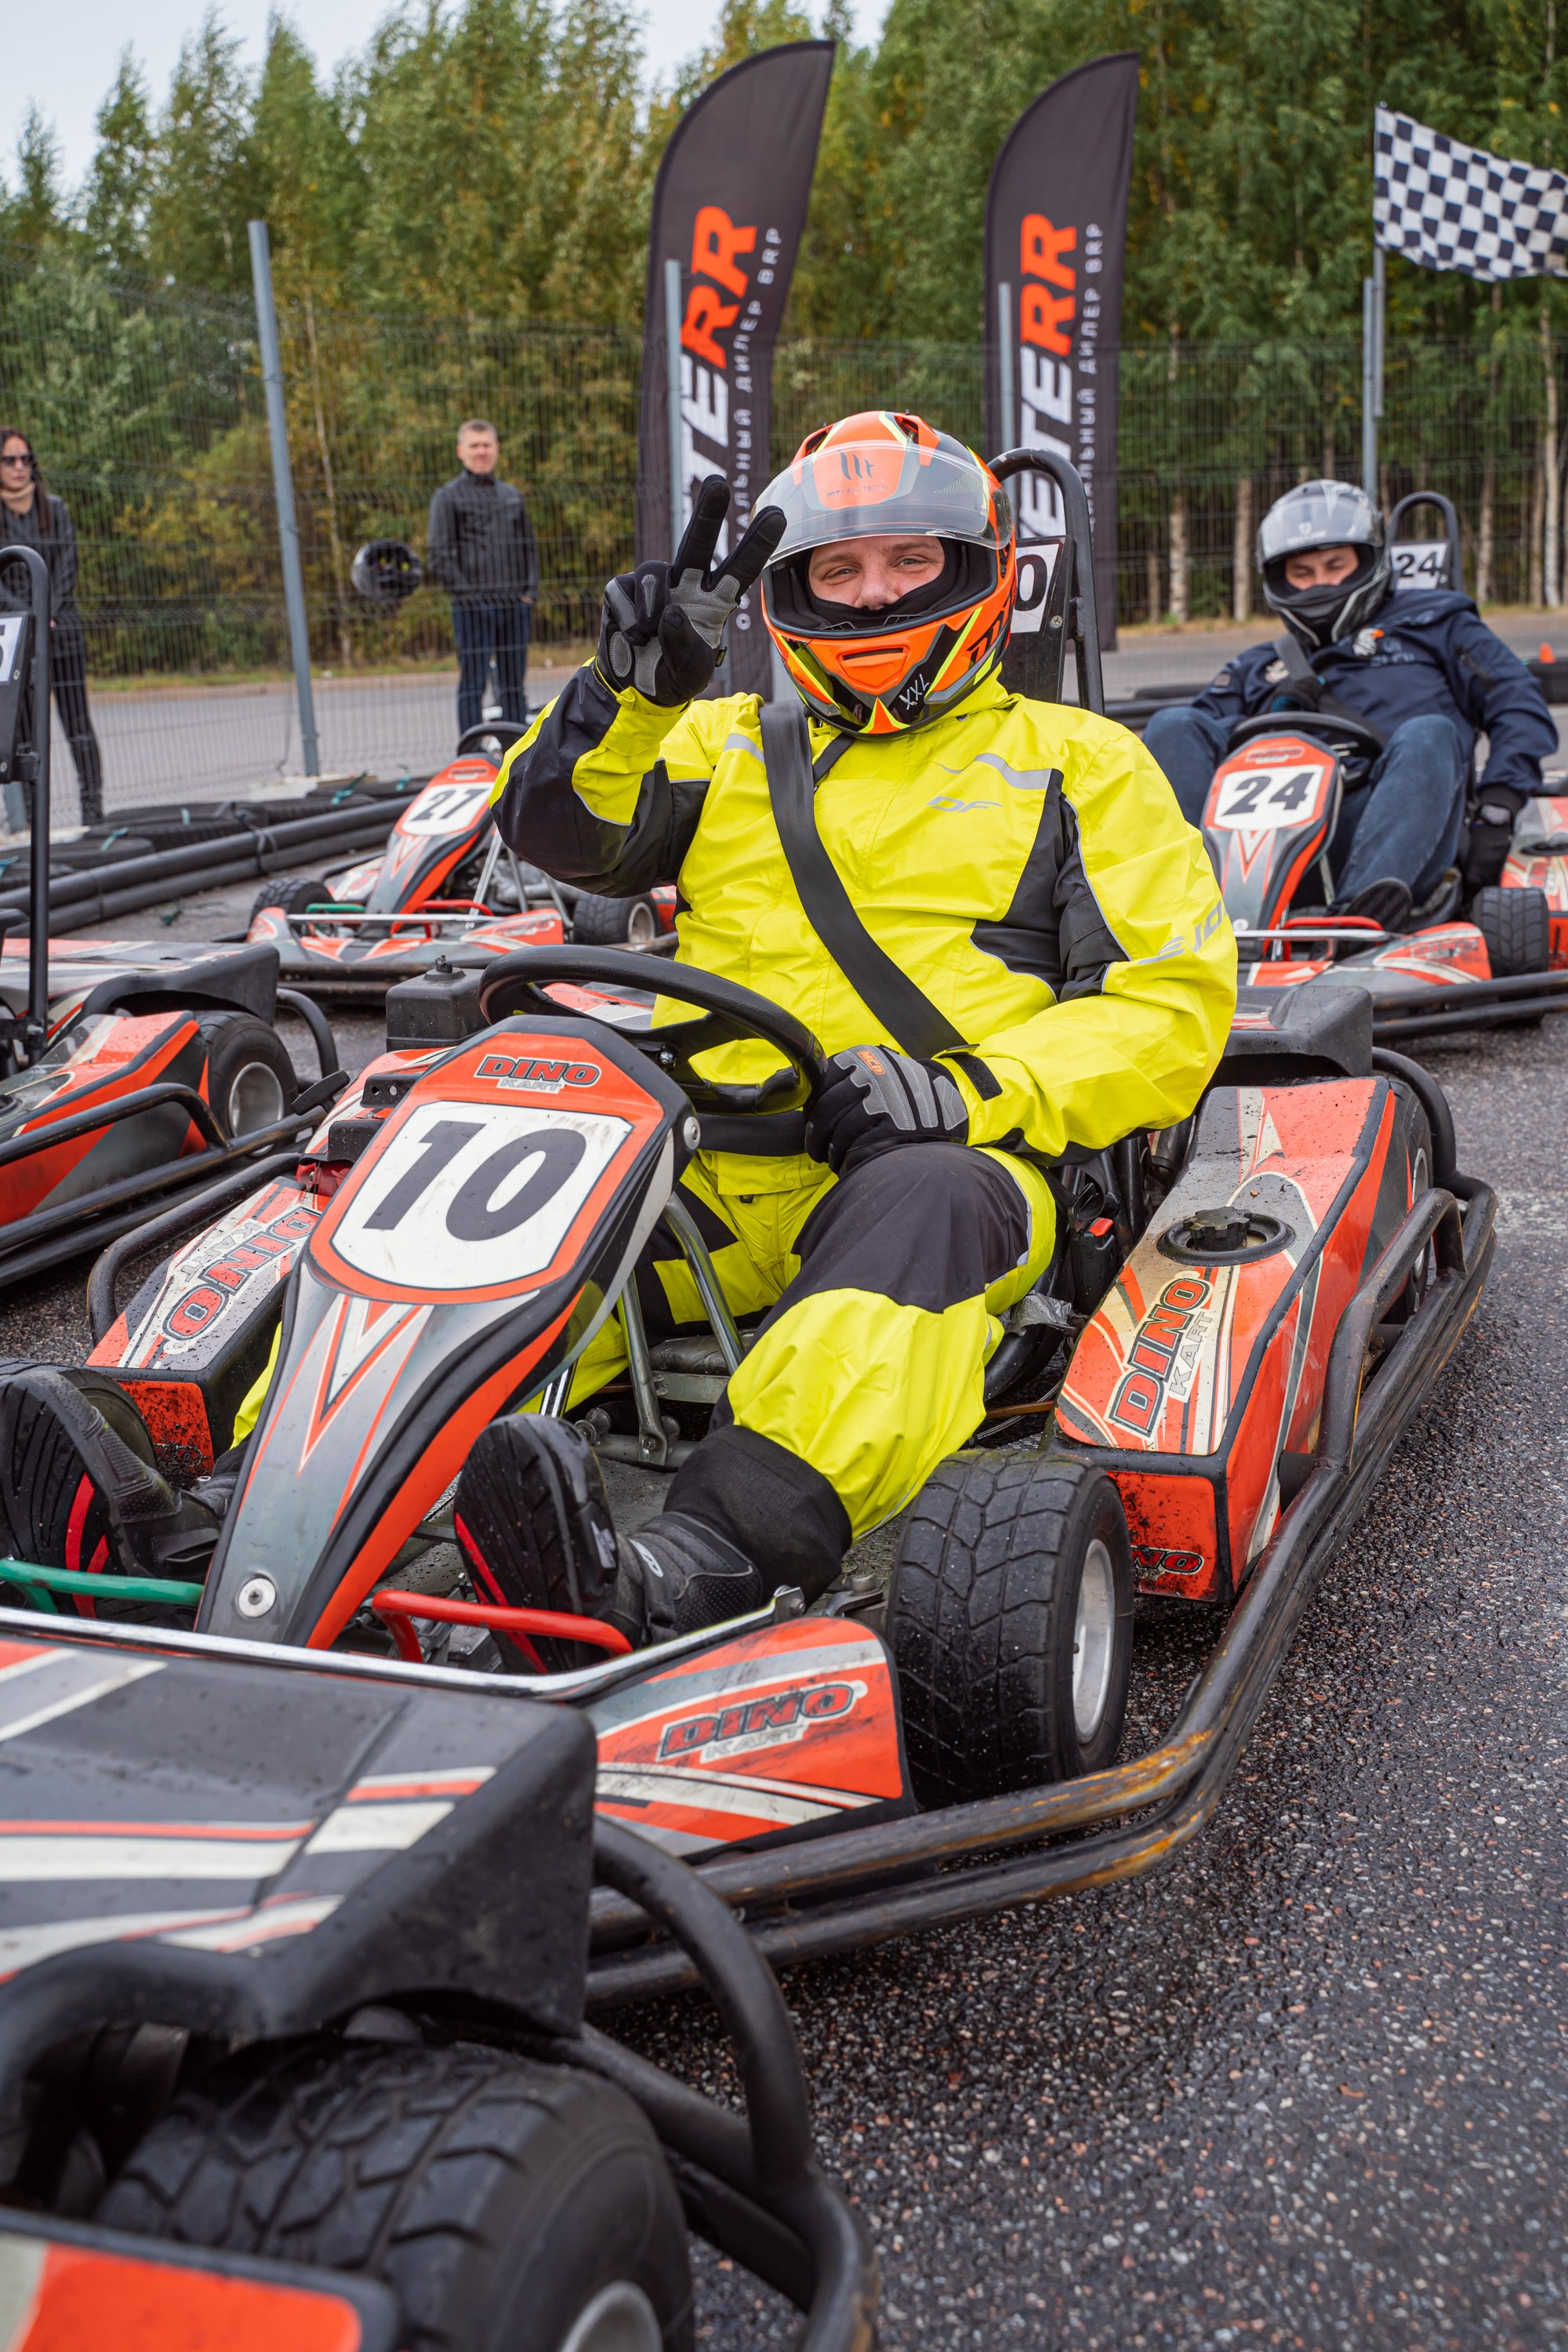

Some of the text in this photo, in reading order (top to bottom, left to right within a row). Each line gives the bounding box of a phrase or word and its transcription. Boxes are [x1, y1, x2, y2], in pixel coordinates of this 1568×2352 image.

[1084, 223, 1104, 274] BRP
[733, 300, 763, 393] ДИЛЕР
[757, 227, 782, 285] BRP
[1078, 287, 1101, 376] ДИЛЕР
[681, 205, 758, 572] TERR
[1020, 212, 1077, 539] ETERR
[1396, 551, 1443, 578] 24
[898, 673, 930, 710] XXL
[409, 789, 489, 822] 27
[1221, 772, 1316, 817] 24
[476, 1055, 600, 1086] DINO
[499, 1078, 562, 1092] KART
[858, 1051, 885, 1074] MCP
[361, 1120, 587, 1242] 10
[162, 1205, 321, 1341] DINO
[180, 1221, 262, 1283] KART
[1108, 1277, 1210, 1438] DINO
[1169, 1311, 1213, 1396] KART
[1131, 1547, 1204, 1574] NO
[659, 1683, 855, 1758] DINO
[705, 1724, 805, 1759] KART
